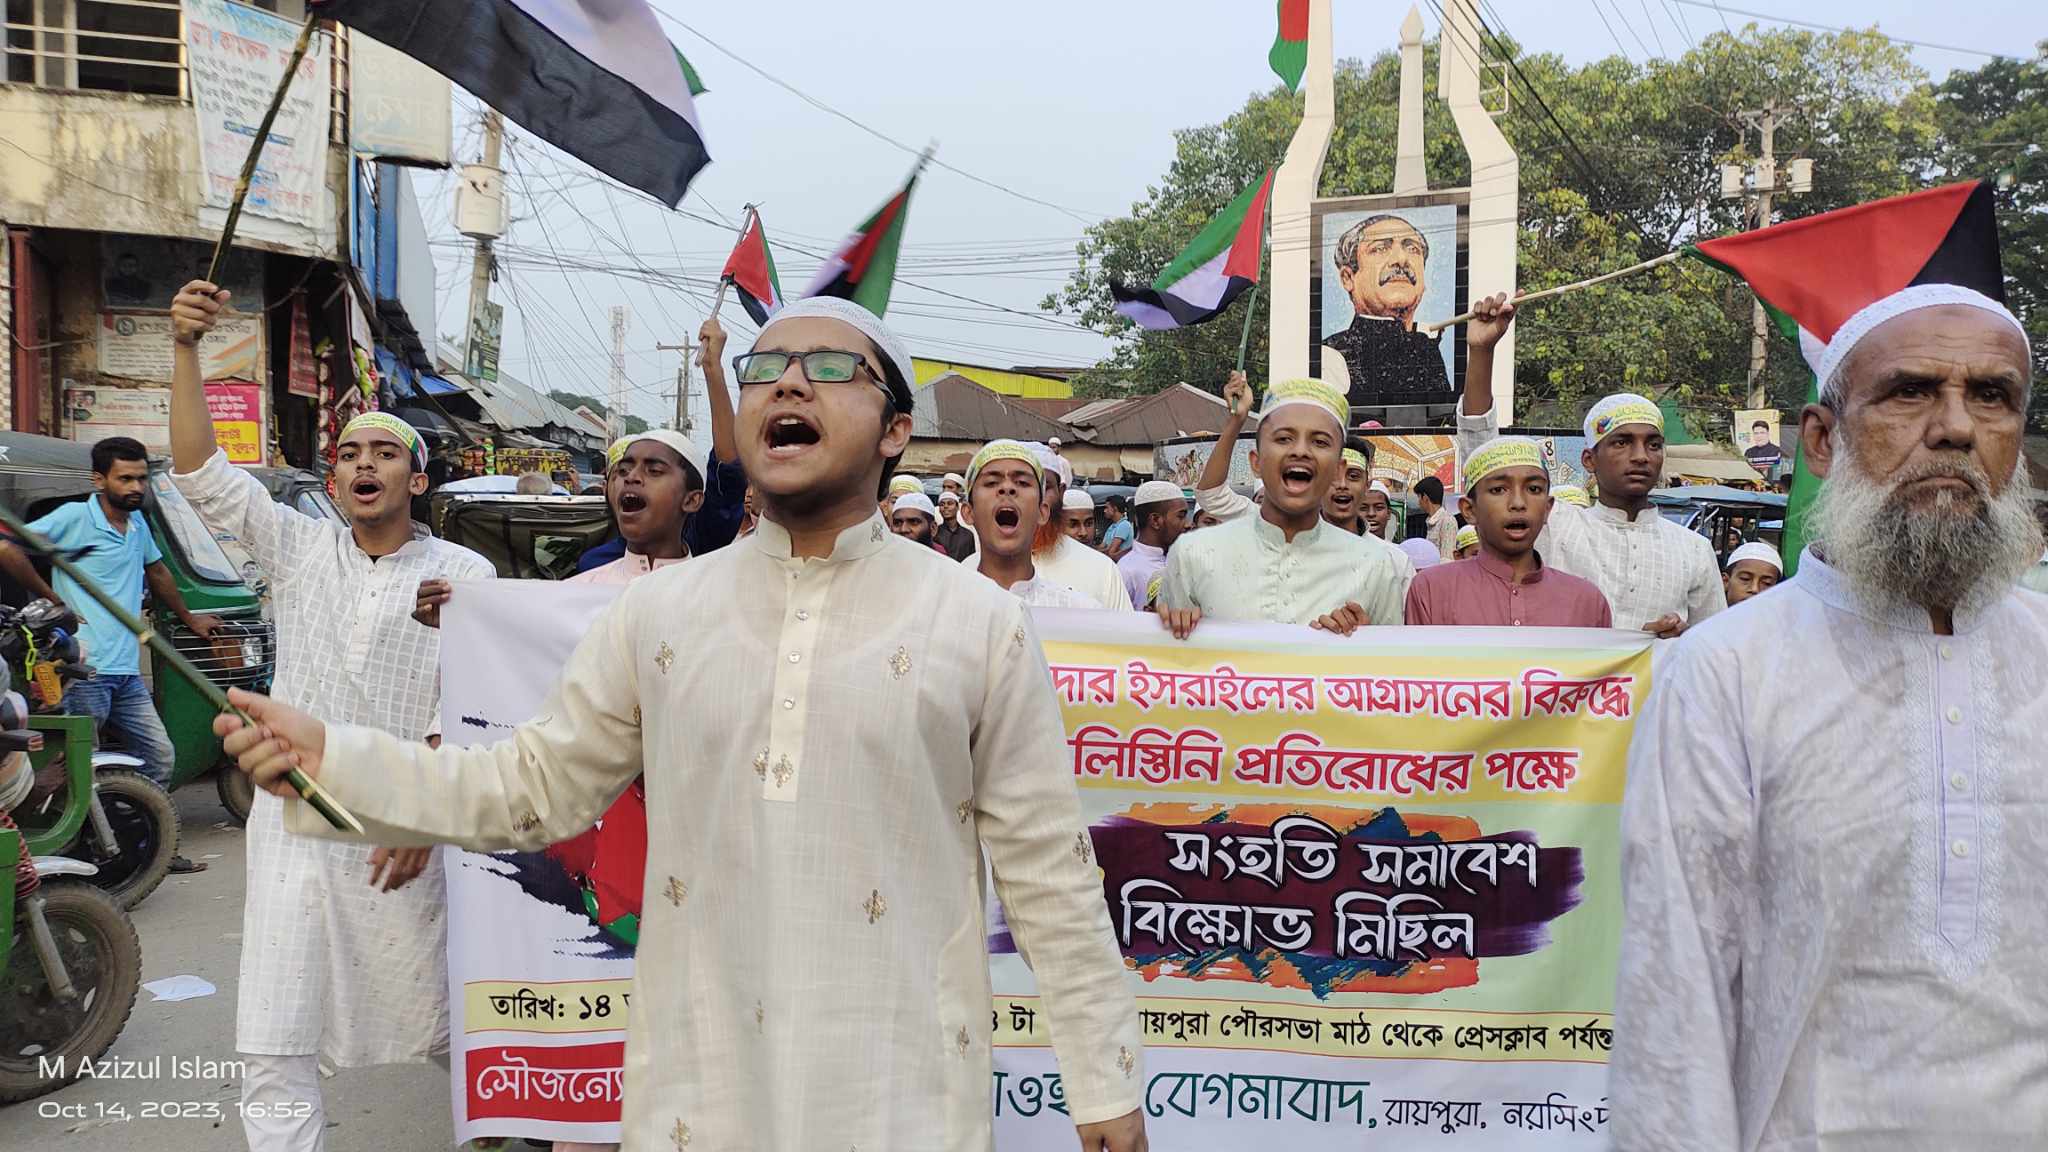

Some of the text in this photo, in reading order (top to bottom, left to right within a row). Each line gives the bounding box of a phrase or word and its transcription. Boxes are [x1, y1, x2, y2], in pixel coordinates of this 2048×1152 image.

[1050, 661, 1632, 717] দার ইসরাইলের আগ্রাসনের বিরুদ্ধে
[1067, 726, 1578, 794] লিস্তিনি প্রতিরোধের পক্ষে
[1164, 817, 1536, 894] সংহতি সমাবেশ
[1120, 878, 1474, 960] বিক্ষোভ মিছিল
[579, 995, 611, 1020] ১৪
[1009, 1003, 1036, 1035] টা
[1139, 1008, 1209, 1041] ায়পুরা
[1220, 1006, 1322, 1043] পৌরসভা
[1330, 1012, 1371, 1045] মাঠ
[1382, 1022, 1444, 1047] থেকে
[1454, 1024, 1548, 1052] প্রেসক্লাব
[1558, 1018, 1613, 1051] পর্যন্ত
[1146, 1072, 1377, 1129] বেগমাবাদ,
[1382, 1100, 1487, 1134] রায়পুরা,
